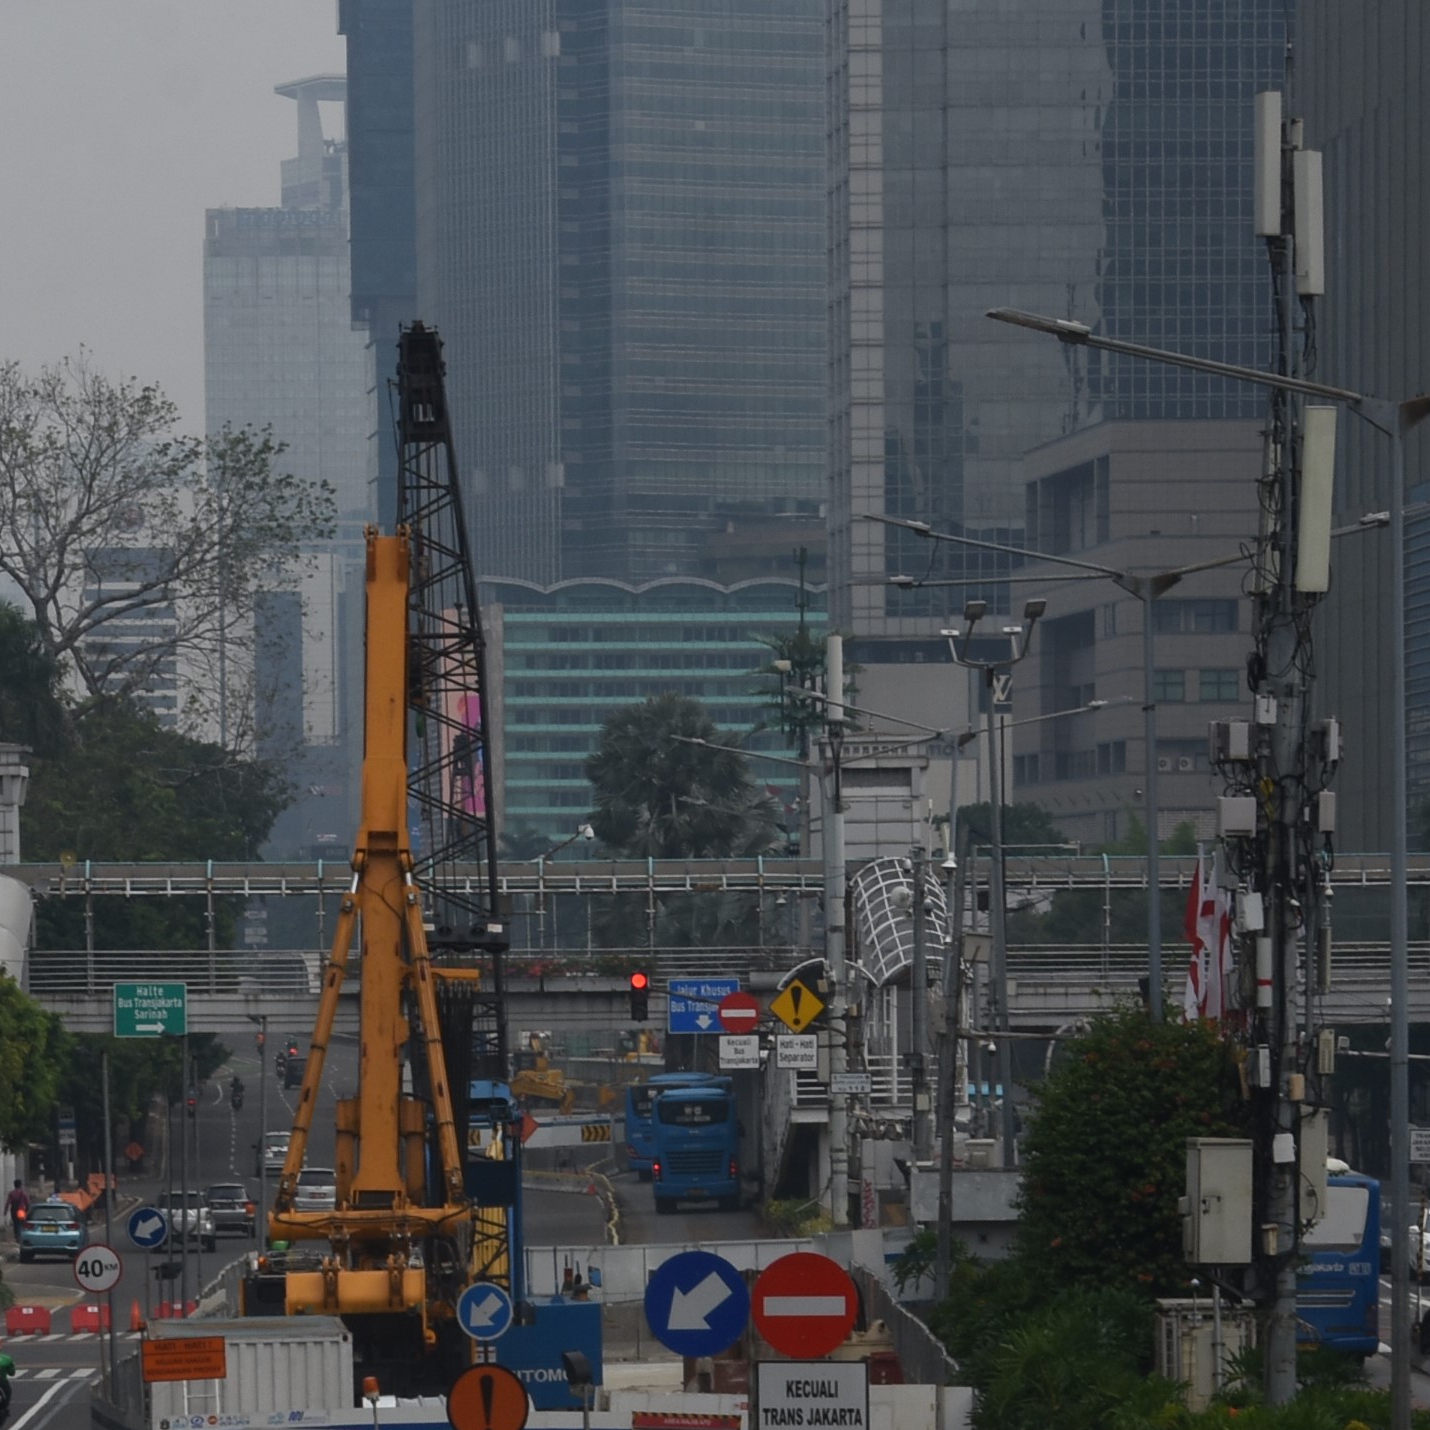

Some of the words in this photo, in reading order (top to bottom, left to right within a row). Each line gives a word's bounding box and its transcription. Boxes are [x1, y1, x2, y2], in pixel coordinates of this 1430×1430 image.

[136, 985, 164, 997] Halte
[118, 997, 133, 1009] Bus
[134, 1009, 169, 1020] Sarinah
[79, 1259, 103, 1278] 40
[786, 1380, 838, 1398] KECUALI
[763, 1408, 804, 1426] TRANS
[806, 1408, 863, 1426] JAKARTA
